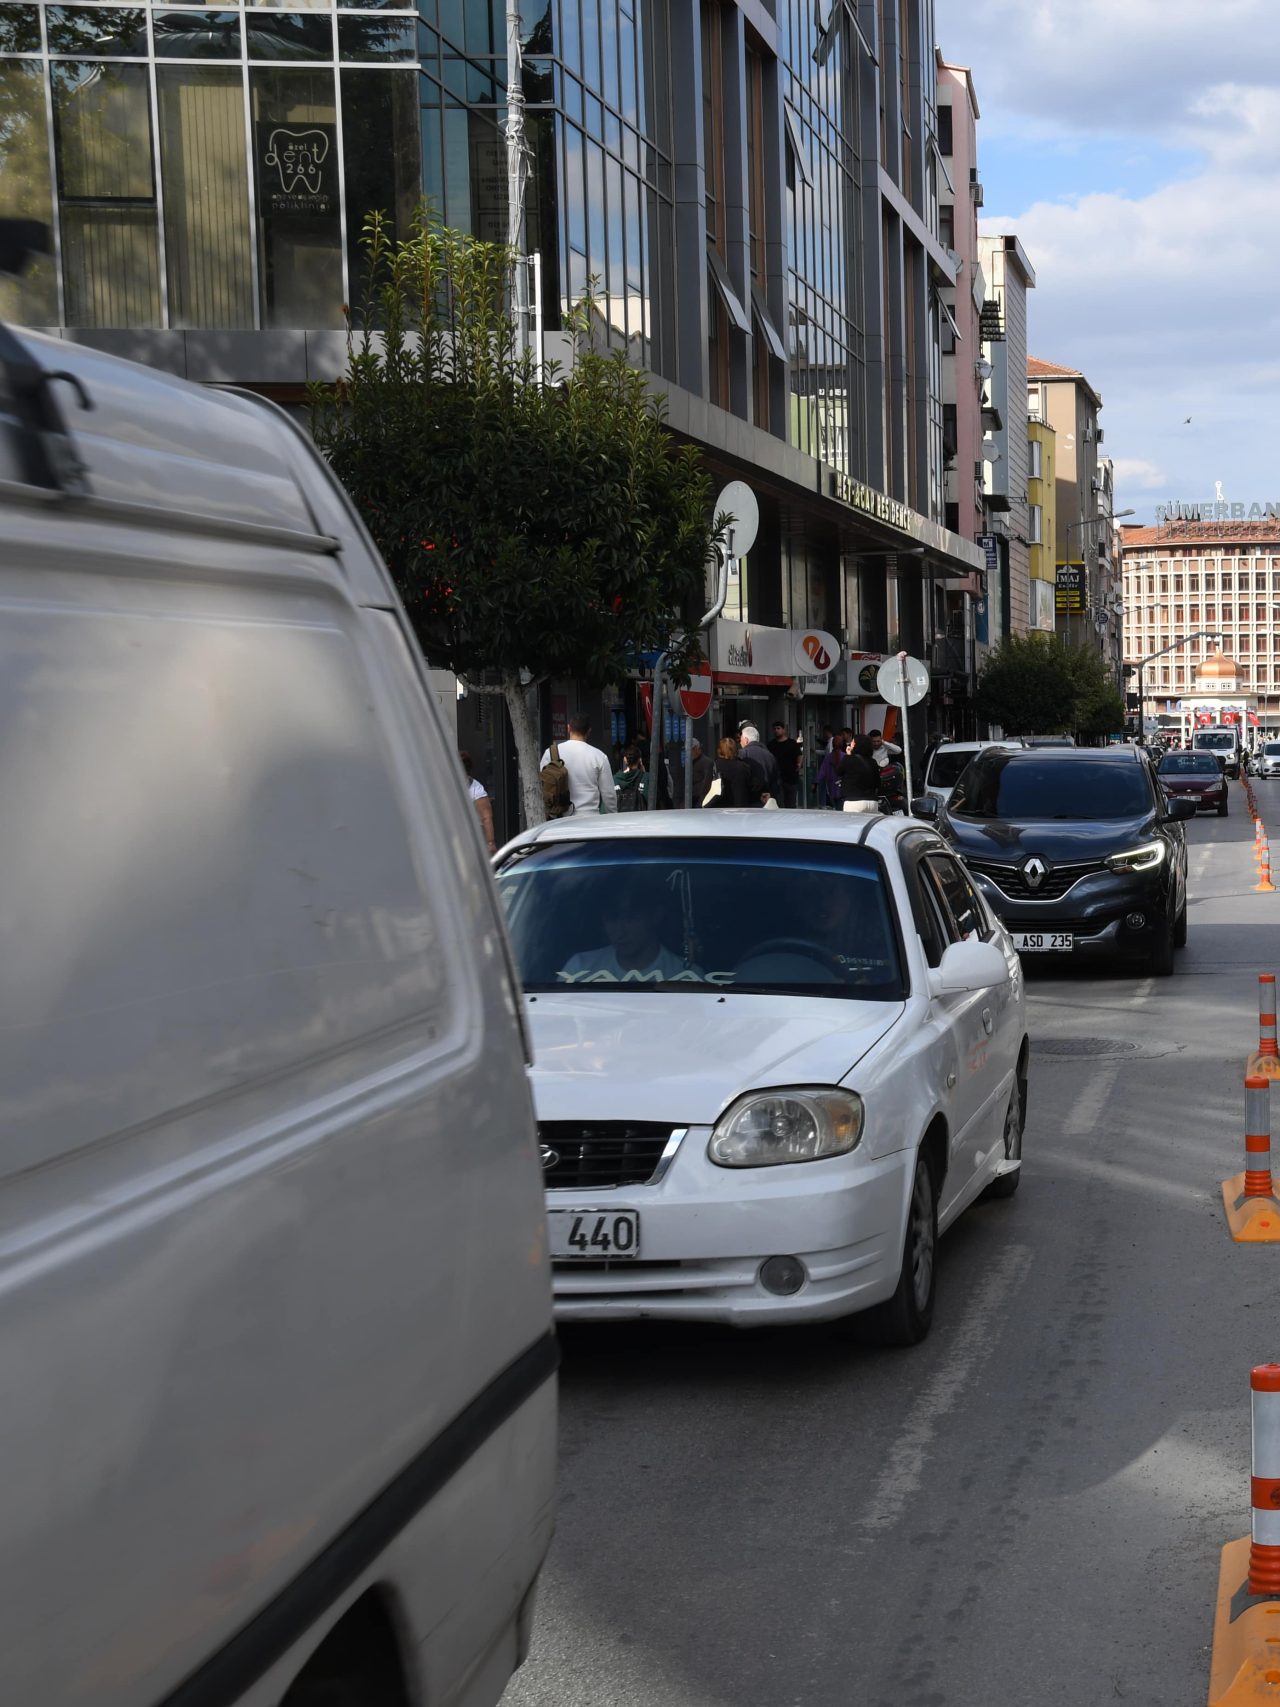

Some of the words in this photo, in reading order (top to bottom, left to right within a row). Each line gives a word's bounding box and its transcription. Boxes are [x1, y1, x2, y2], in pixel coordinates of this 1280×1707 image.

[286, 163, 316, 174] 266
[1022, 934, 1044, 948] ASD
[1050, 934, 1073, 948] 235
[567, 1216, 634, 1251] 440
